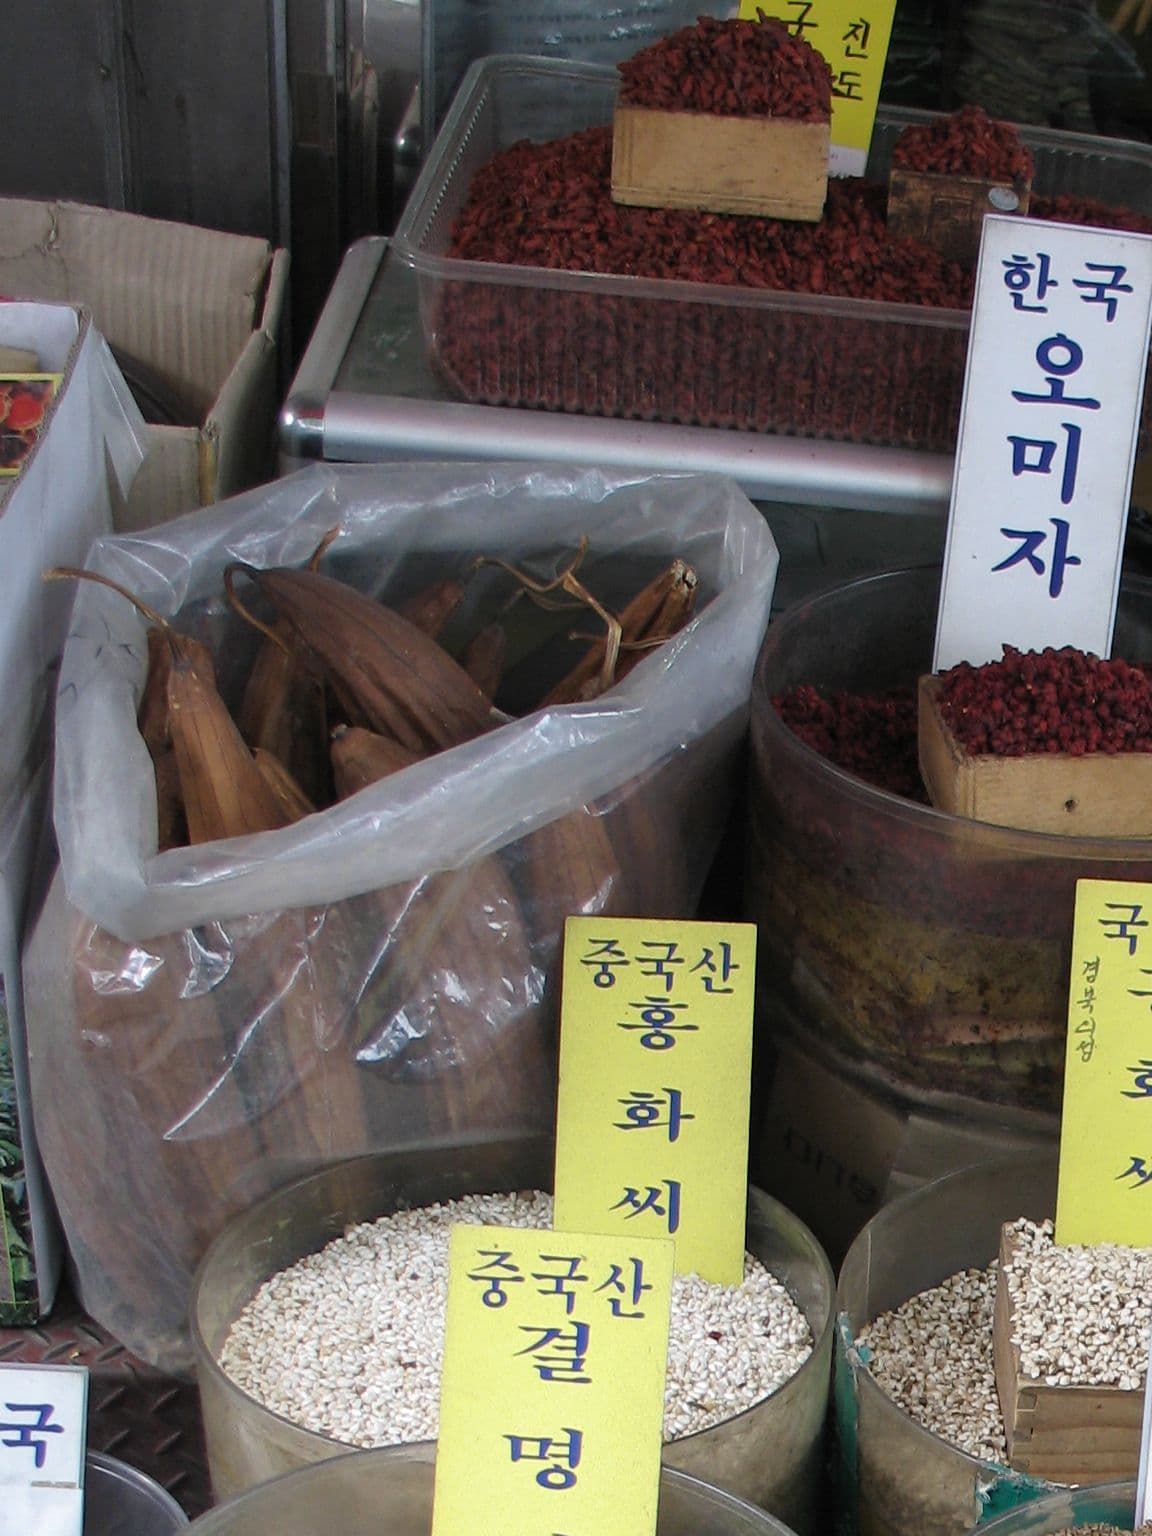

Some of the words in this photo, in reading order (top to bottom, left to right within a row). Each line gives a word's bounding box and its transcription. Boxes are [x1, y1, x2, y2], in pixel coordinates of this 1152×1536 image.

[1001, 252, 1134, 323] 한국
[990, 332, 1102, 599] 오미자
[579, 938, 741, 994] 중국산
[608, 995, 700, 1235] 홍화씨
[466, 1248, 654, 1320] 중국산
[0, 1402, 65, 1469] 국
